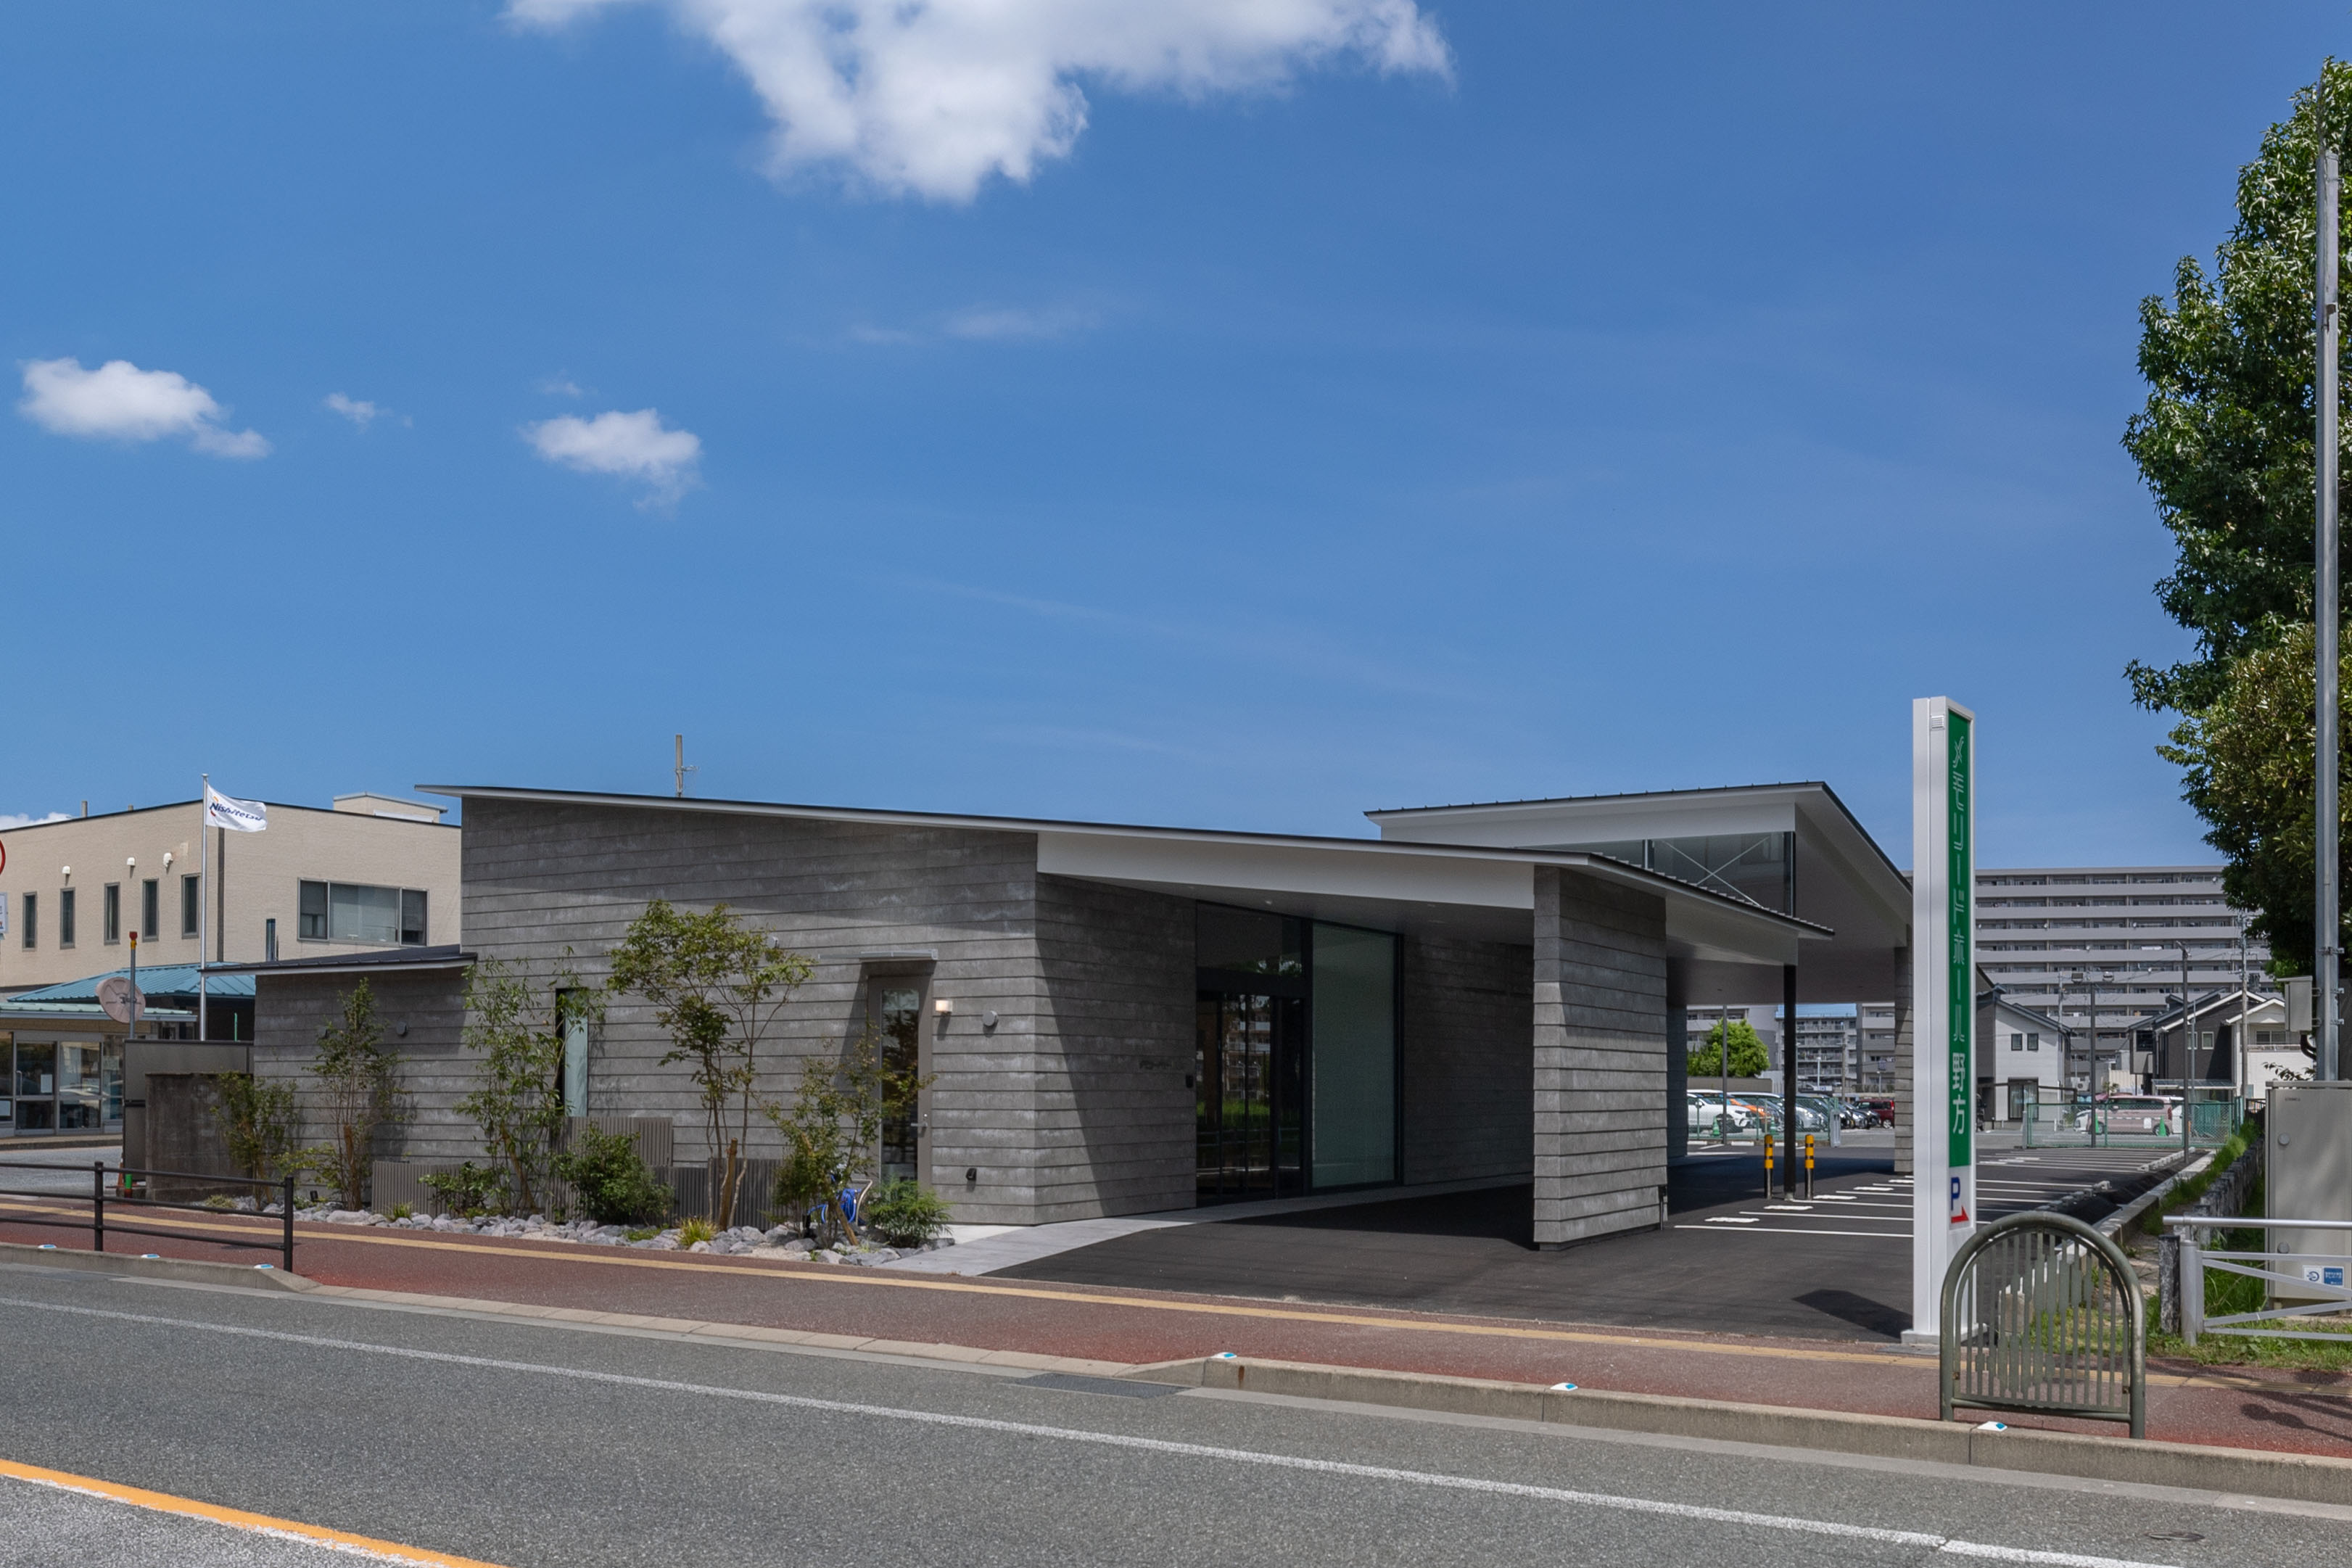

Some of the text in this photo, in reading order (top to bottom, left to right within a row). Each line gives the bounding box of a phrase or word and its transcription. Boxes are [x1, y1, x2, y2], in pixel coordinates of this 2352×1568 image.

[210, 802, 262, 821] Nishitetsu
[1952, 735, 1966, 1134] メモリードホール 野方
[1950, 1176, 1961, 1210] P
